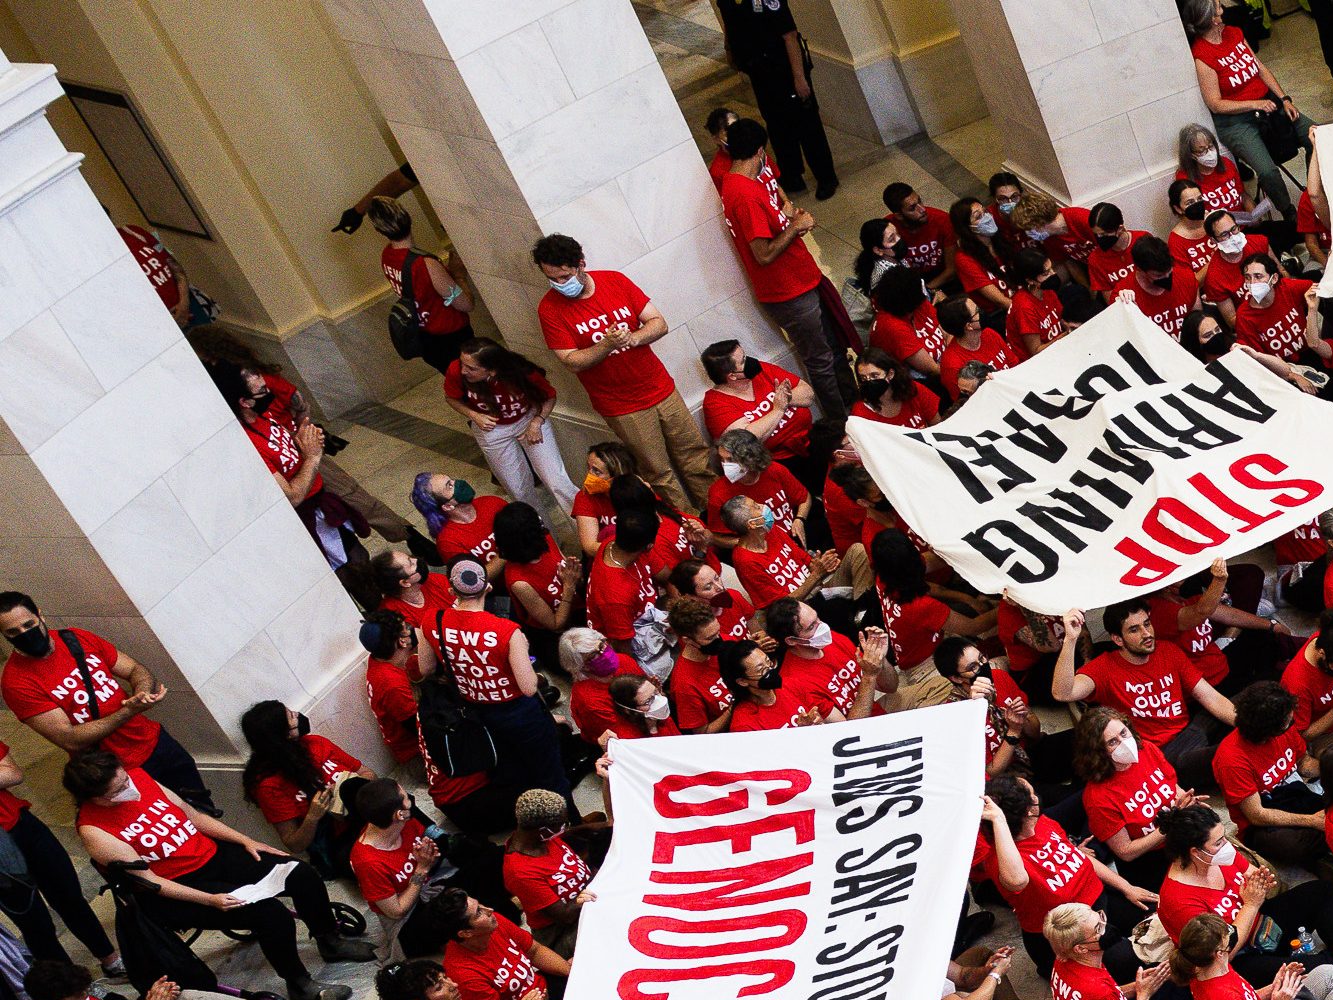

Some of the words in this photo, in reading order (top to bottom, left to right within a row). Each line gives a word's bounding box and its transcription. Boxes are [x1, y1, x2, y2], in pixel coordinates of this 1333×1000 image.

[1218, 52, 1237, 67] NOT
[1235, 41, 1247, 55] IN
[1229, 53, 1253, 73] OUR
[575, 313, 608, 335] NOT
[613, 306, 631, 321] IN
[961, 358, 1277, 584] ARMING
[1114, 453, 1324, 587] STOP
[780, 543, 793, 558] IN
[774, 558, 799, 587] OUR
[52, 668, 84, 700] NOT
[1125, 681, 1154, 695] NOT
[1159, 673, 1174, 689] IN
[1135, 690, 1171, 709] OUR
[832, 736, 923, 828] JEWS
[1124, 782, 1150, 812] NOT
[1150, 767, 1167, 784] IN
[1141, 784, 1174, 818] OUR
[120, 813, 151, 841] NOT
[148, 799, 169, 815] IN
[140, 813, 181, 848] OUR
[140, 819, 198, 863] NAME
